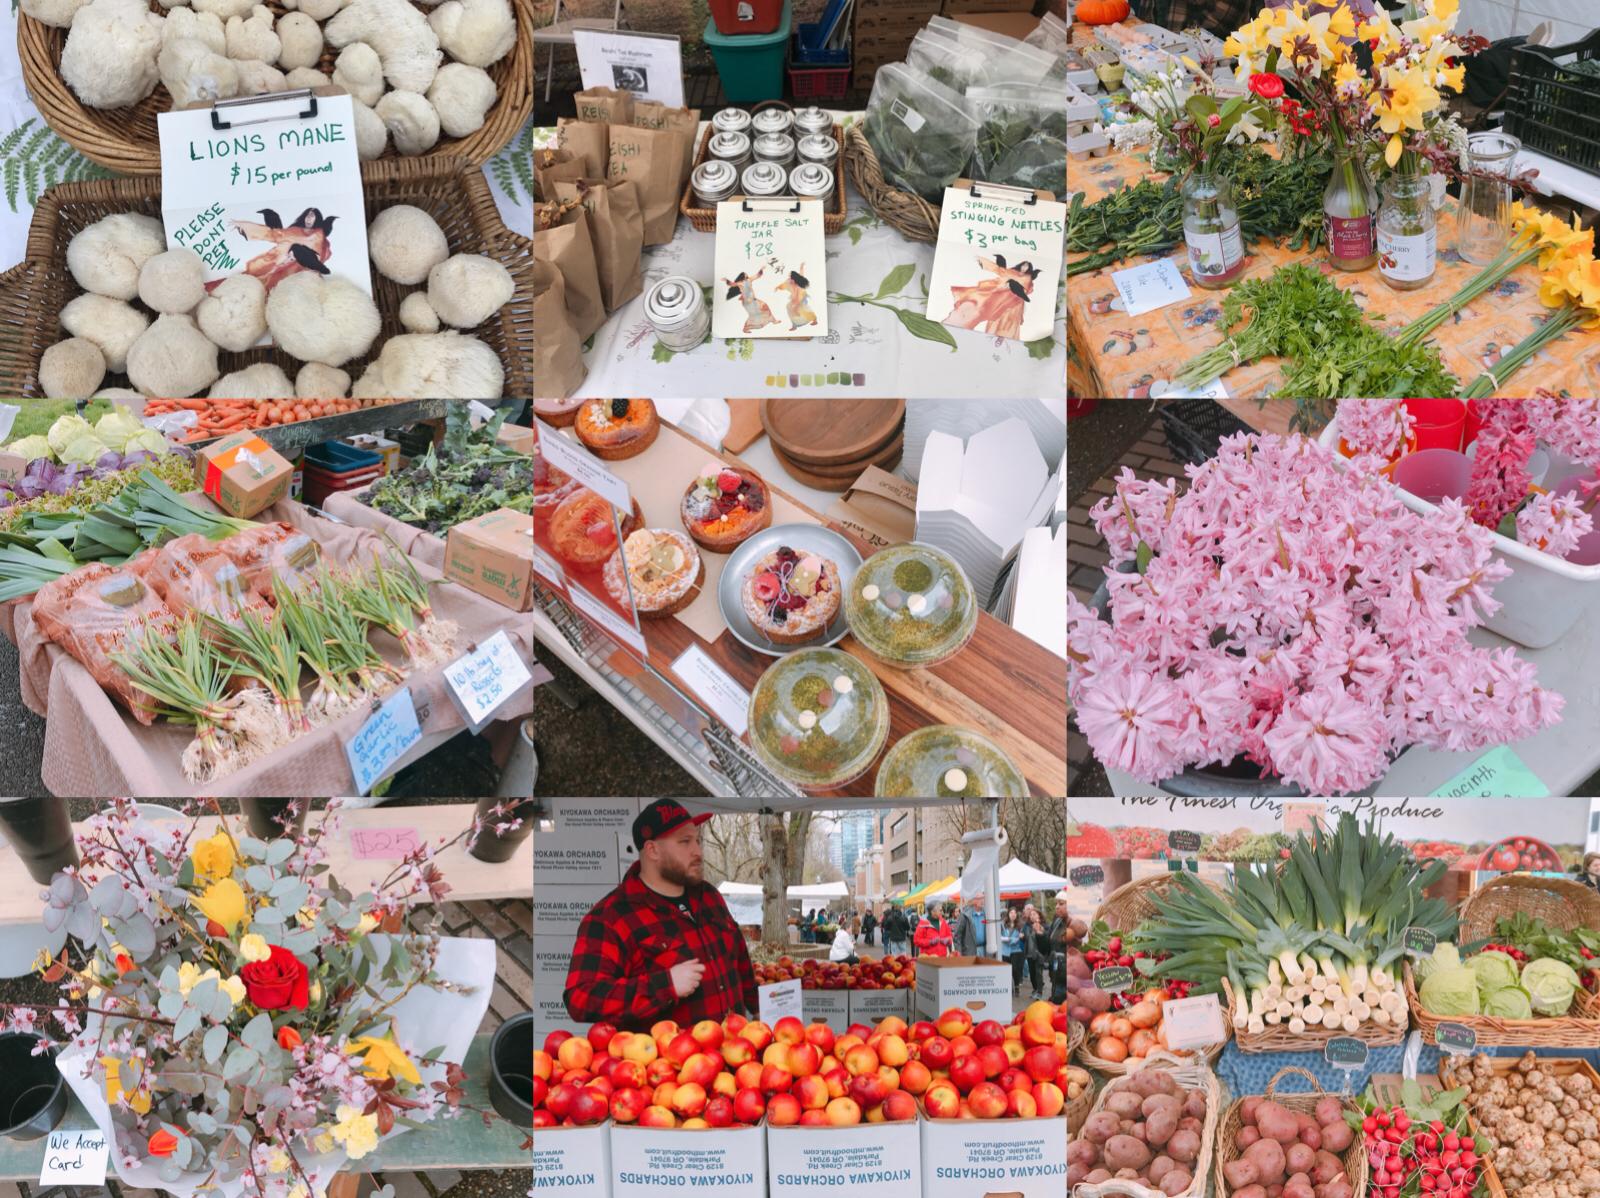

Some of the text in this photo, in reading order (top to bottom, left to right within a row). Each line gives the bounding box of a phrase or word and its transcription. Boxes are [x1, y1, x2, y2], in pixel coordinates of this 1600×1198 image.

[189, 124, 346, 161] LIONS MANE
[271, 168, 291, 185] per
[296, 161, 333, 180] pound
[964, 200, 1026, 216] SPRING-FED
[174, 202, 225, 246] PLEASE
[734, 218, 809, 230] TRUFFLE SALT
[950, 211, 1063, 232] STINGING NETTLES
[193, 220, 226, 255] DONT
[751, 229, 774, 239] JAR
[964, 228, 1037, 251] $3 per bag
[202, 240, 229, 265] PET
[744, 241, 774, 260] $28
[1438, 765, 1496, 797] acinth
[560, 808, 630, 816] KIYOKAWA ORCHARDS
[1351, 797, 1444, 818] Produce
[354, 830, 415, 858] $25
[566, 850, 606, 858] ORCHARDS
[50, 1133, 106, 1152] We Accept
[48, 1154, 84, 1171] Card
[620, 1172, 753, 1186] KIYOKAWA ORCHARDS
[777, 1169, 911, 1186] KIYOKAWA ORCHARDS
[936, 1167, 1005, 1178] ORCHARDS
